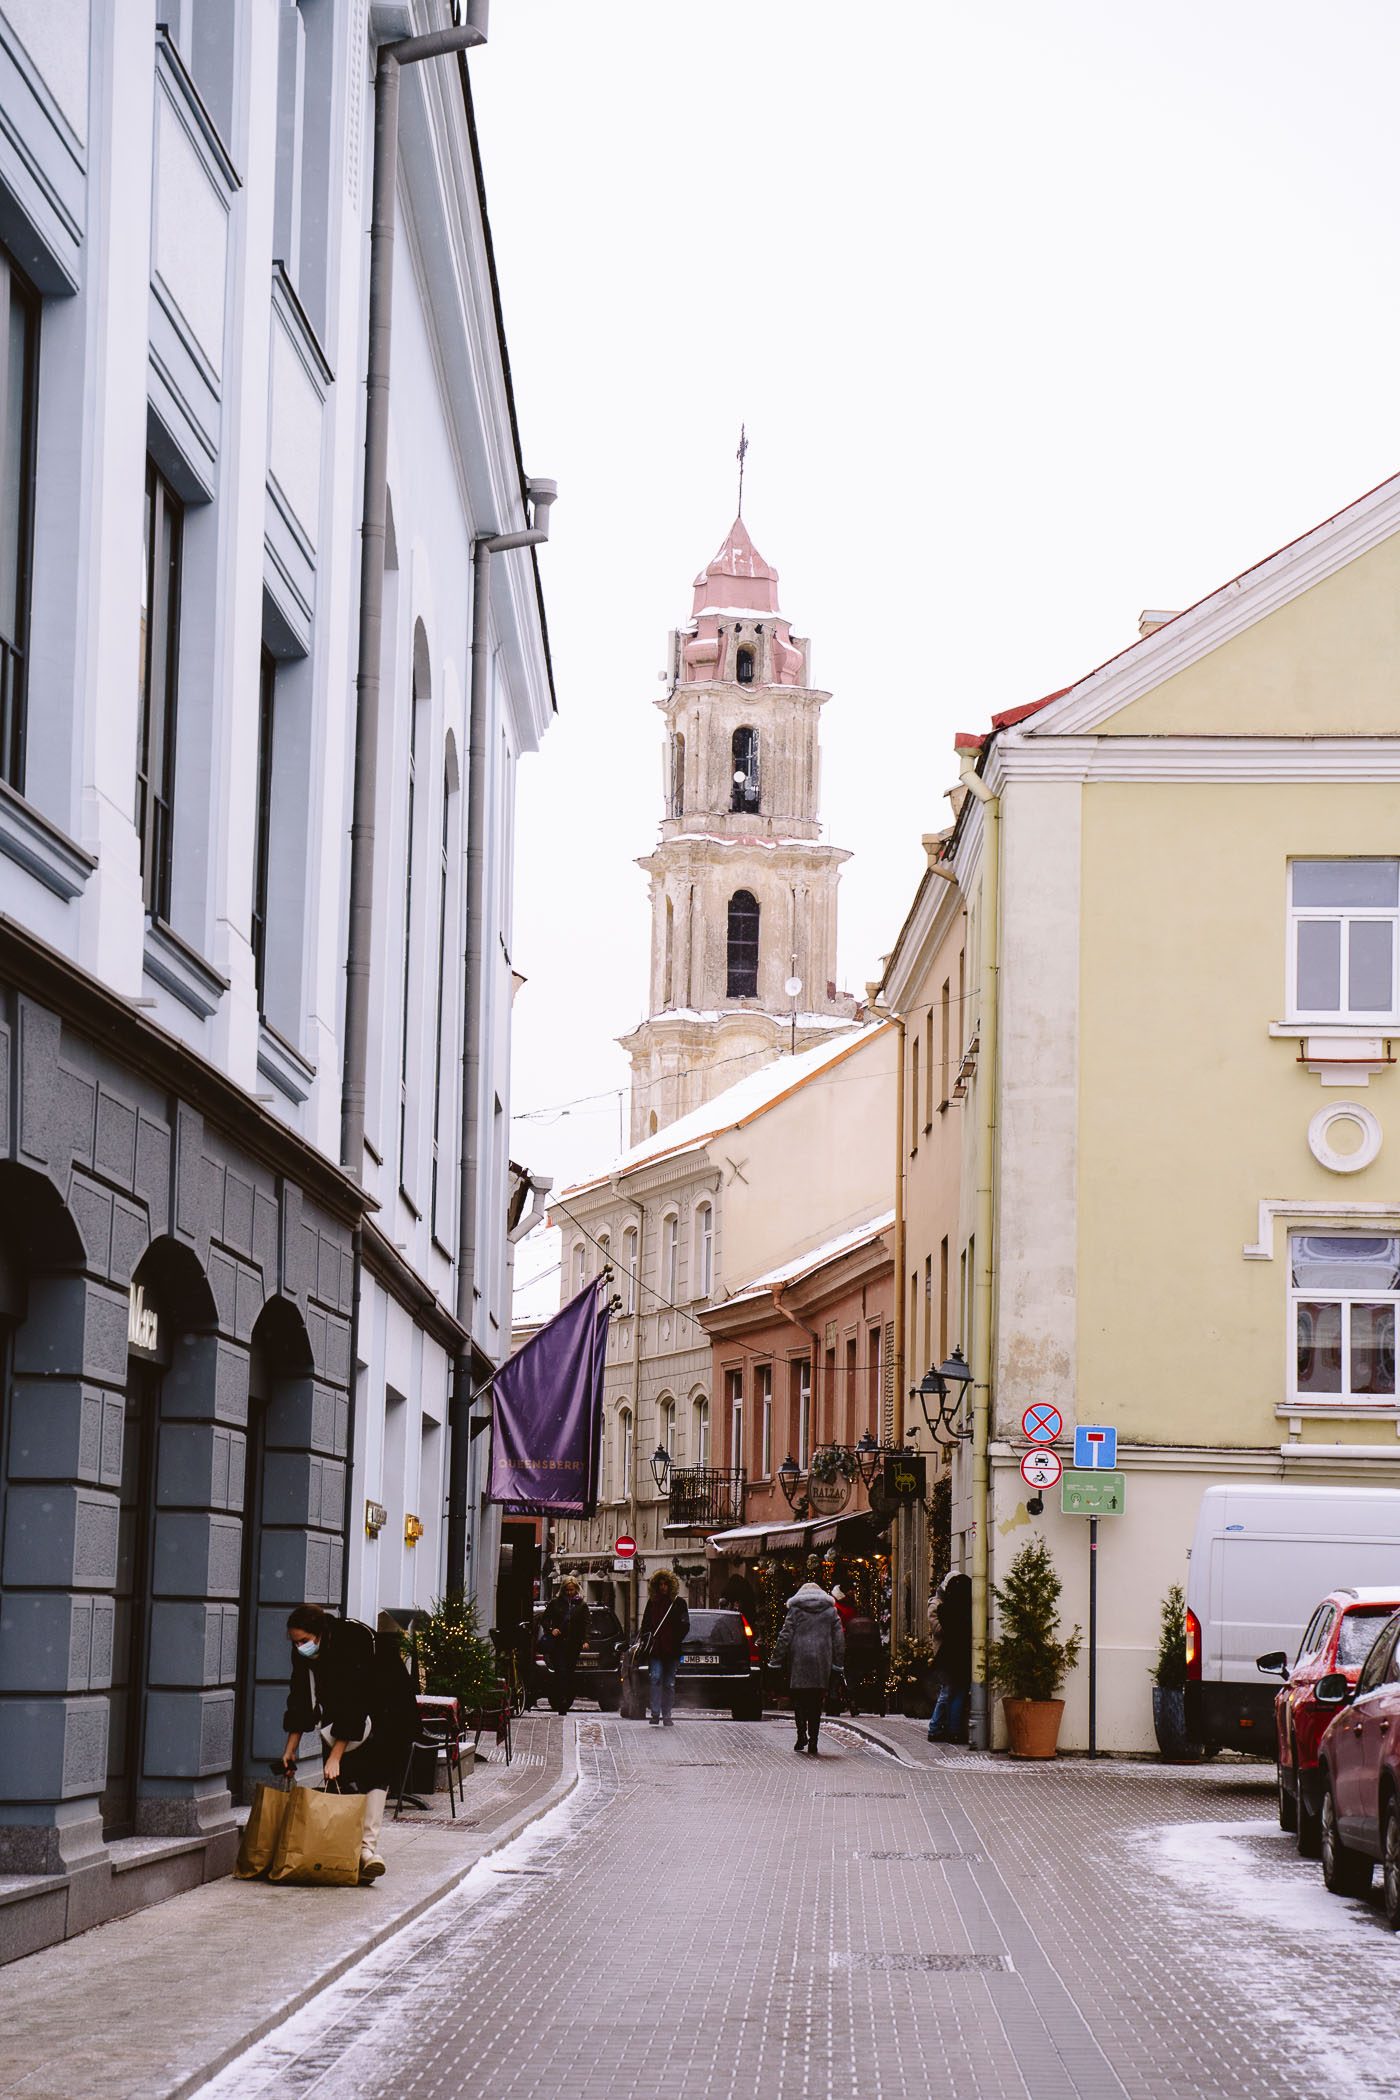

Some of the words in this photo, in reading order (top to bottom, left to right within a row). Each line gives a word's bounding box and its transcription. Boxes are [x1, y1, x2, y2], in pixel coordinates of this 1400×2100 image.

[498, 1458, 585, 1471] QUEENSBERRY
[812, 1487, 846, 1499] BALZAC
[684, 1655, 701, 1663] JMB
[704, 1655, 718, 1663] 531
